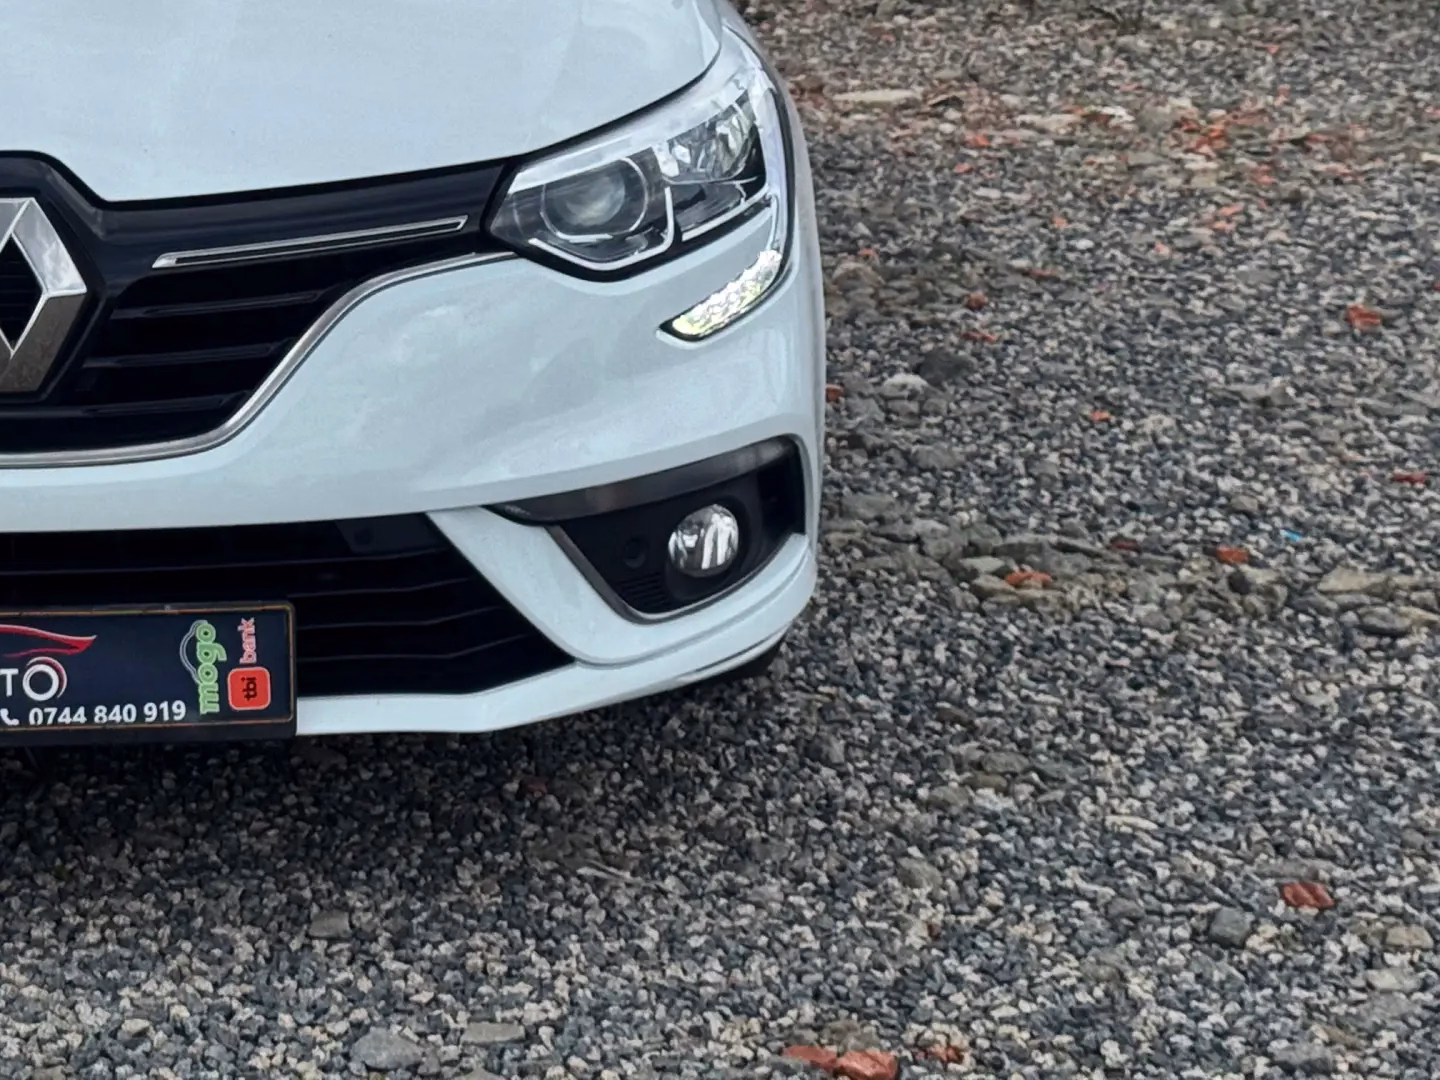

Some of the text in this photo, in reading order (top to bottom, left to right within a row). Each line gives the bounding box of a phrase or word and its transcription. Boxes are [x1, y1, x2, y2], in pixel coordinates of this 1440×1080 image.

[195, 622, 228, 716] mogo
[237, 617, 258, 702] tbi bank
[28, 699, 187, 726] 0744 840 919
